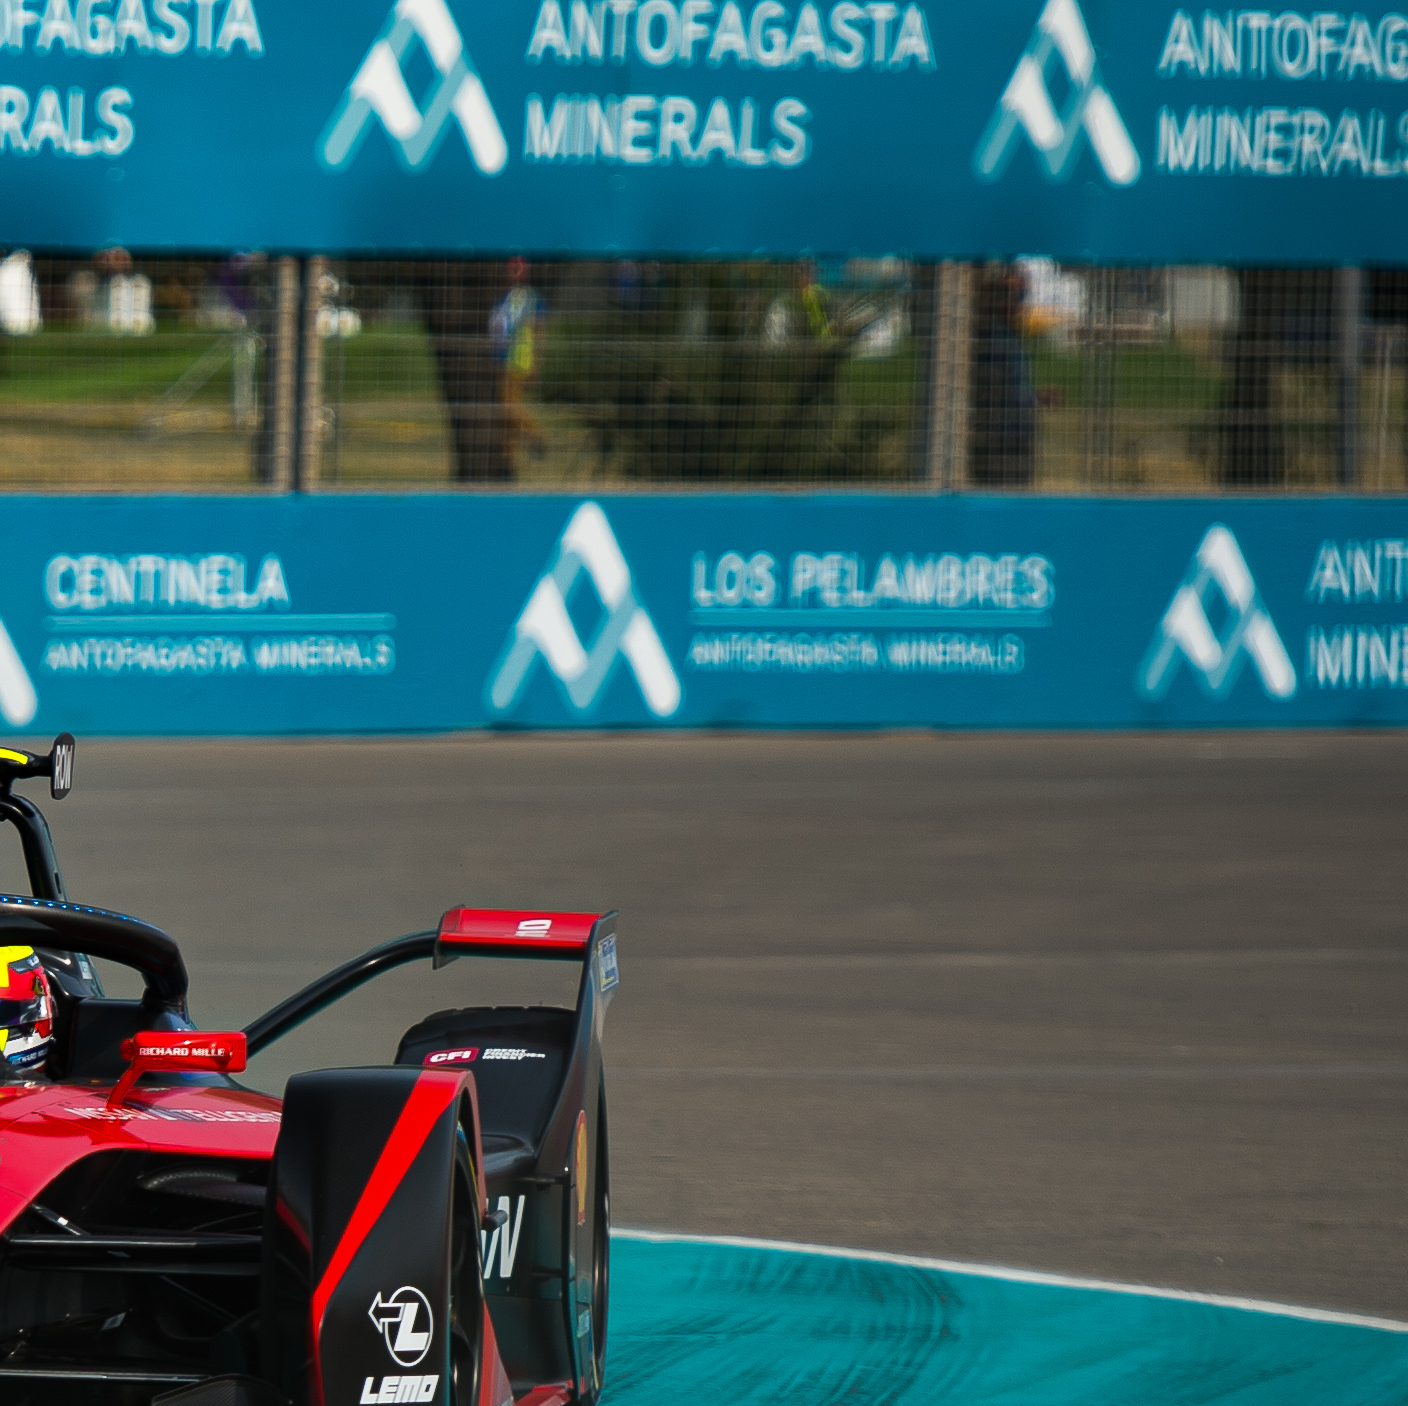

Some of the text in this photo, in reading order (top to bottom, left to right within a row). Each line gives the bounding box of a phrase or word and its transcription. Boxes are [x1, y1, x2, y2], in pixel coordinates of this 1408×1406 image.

[526, 0, 937, 71] ANTOFAGASTA
[524, 93, 812, 166] MINERALS
[44, 552, 290, 610] CENTINELA
[692, 551, 1054, 609] LOS PELAMBRES
[1306, 624, 1408, 690] MIN
[139, 1047, 225, 1057] RICHARD MILLE
[430, 1050, 472, 1063] CFI
[360, 1375, 439, 1404] LEMO
